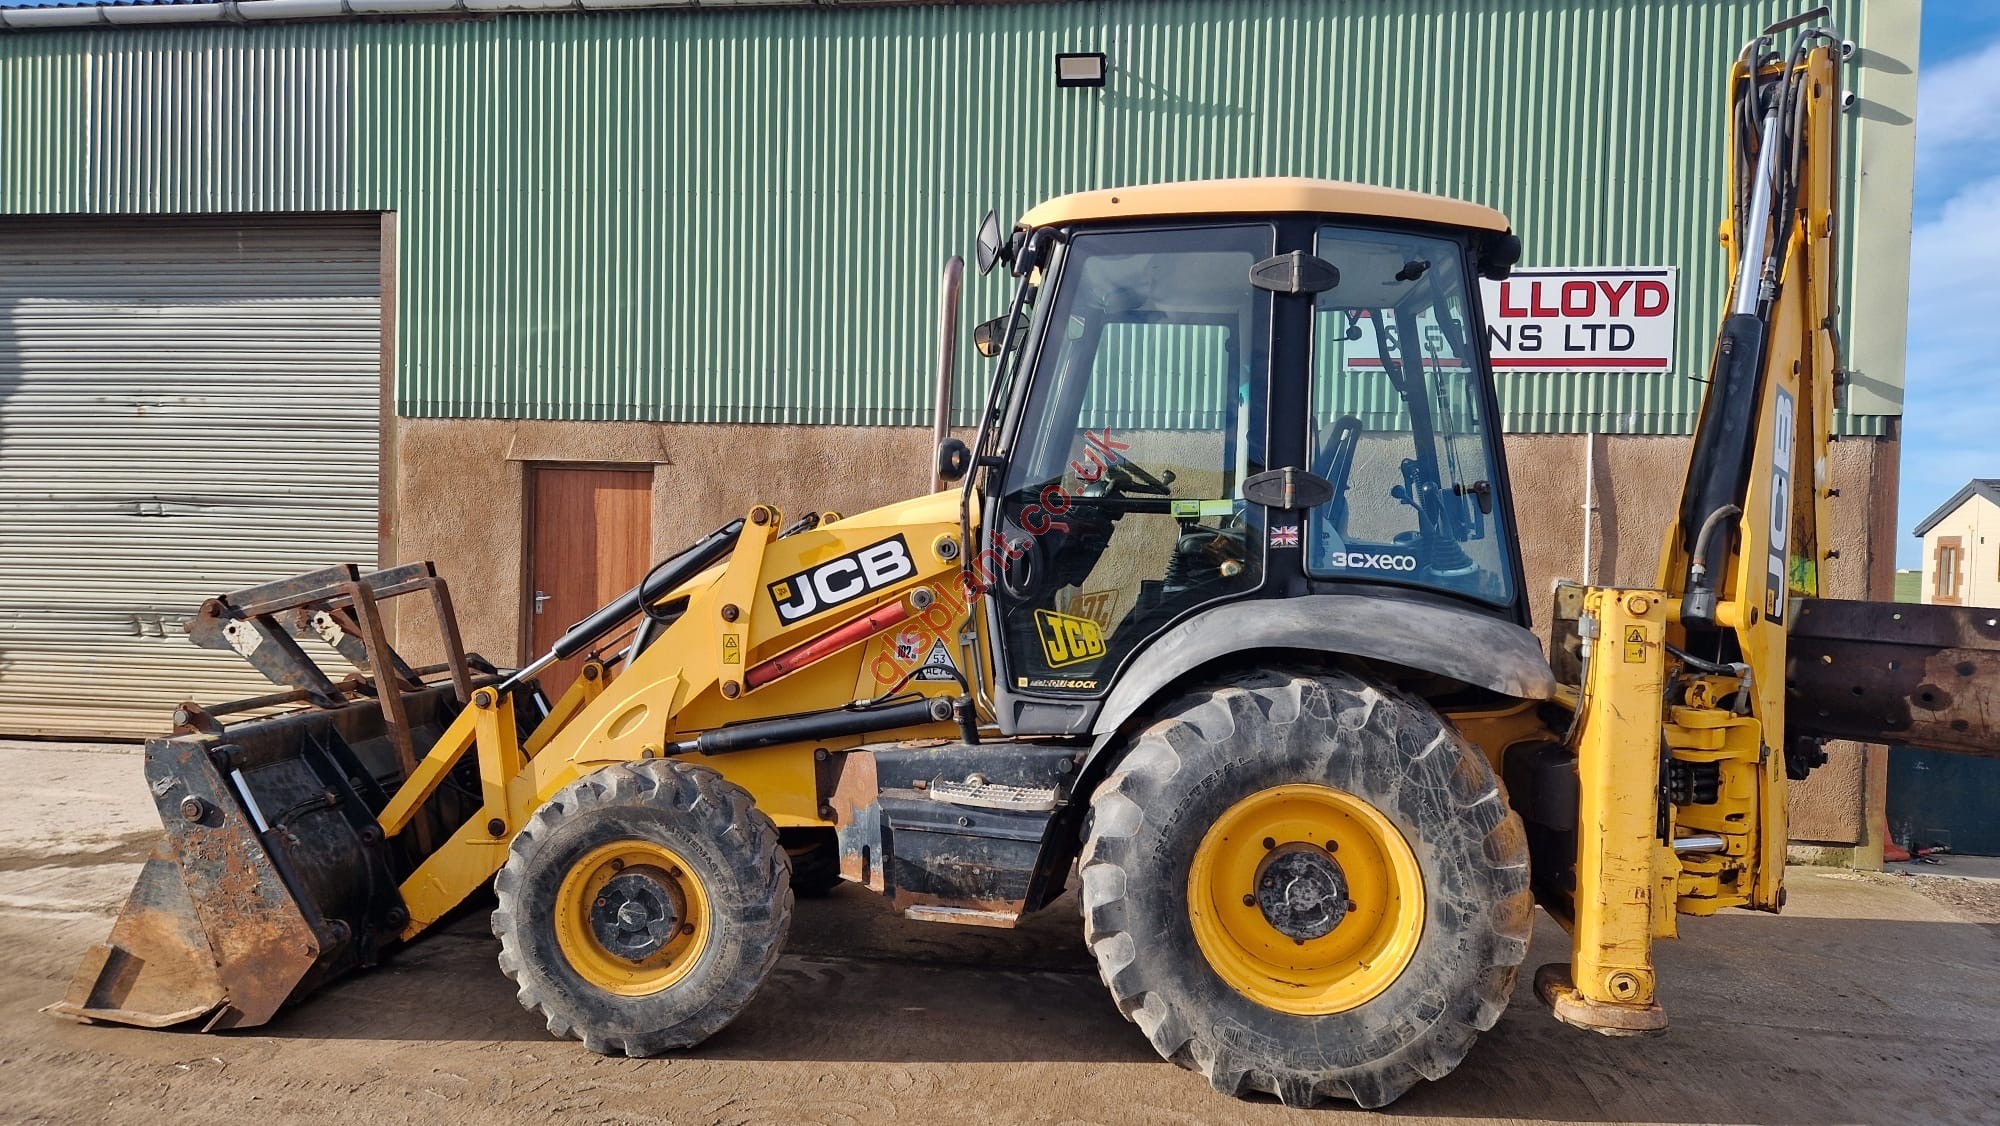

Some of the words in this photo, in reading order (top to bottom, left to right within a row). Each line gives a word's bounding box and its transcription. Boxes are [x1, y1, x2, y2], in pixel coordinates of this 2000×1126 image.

[1499, 280, 1670, 318] LLOYD
[1564, 324, 1636, 352] LTD
[1768, 394, 1793, 618] JCB
[777, 540, 912, 620] JCB
[933, 654, 946, 664] 53
[1045, 616, 1101, 662] JCB
[1152, 758, 1253, 863] INDUSTRIAL
